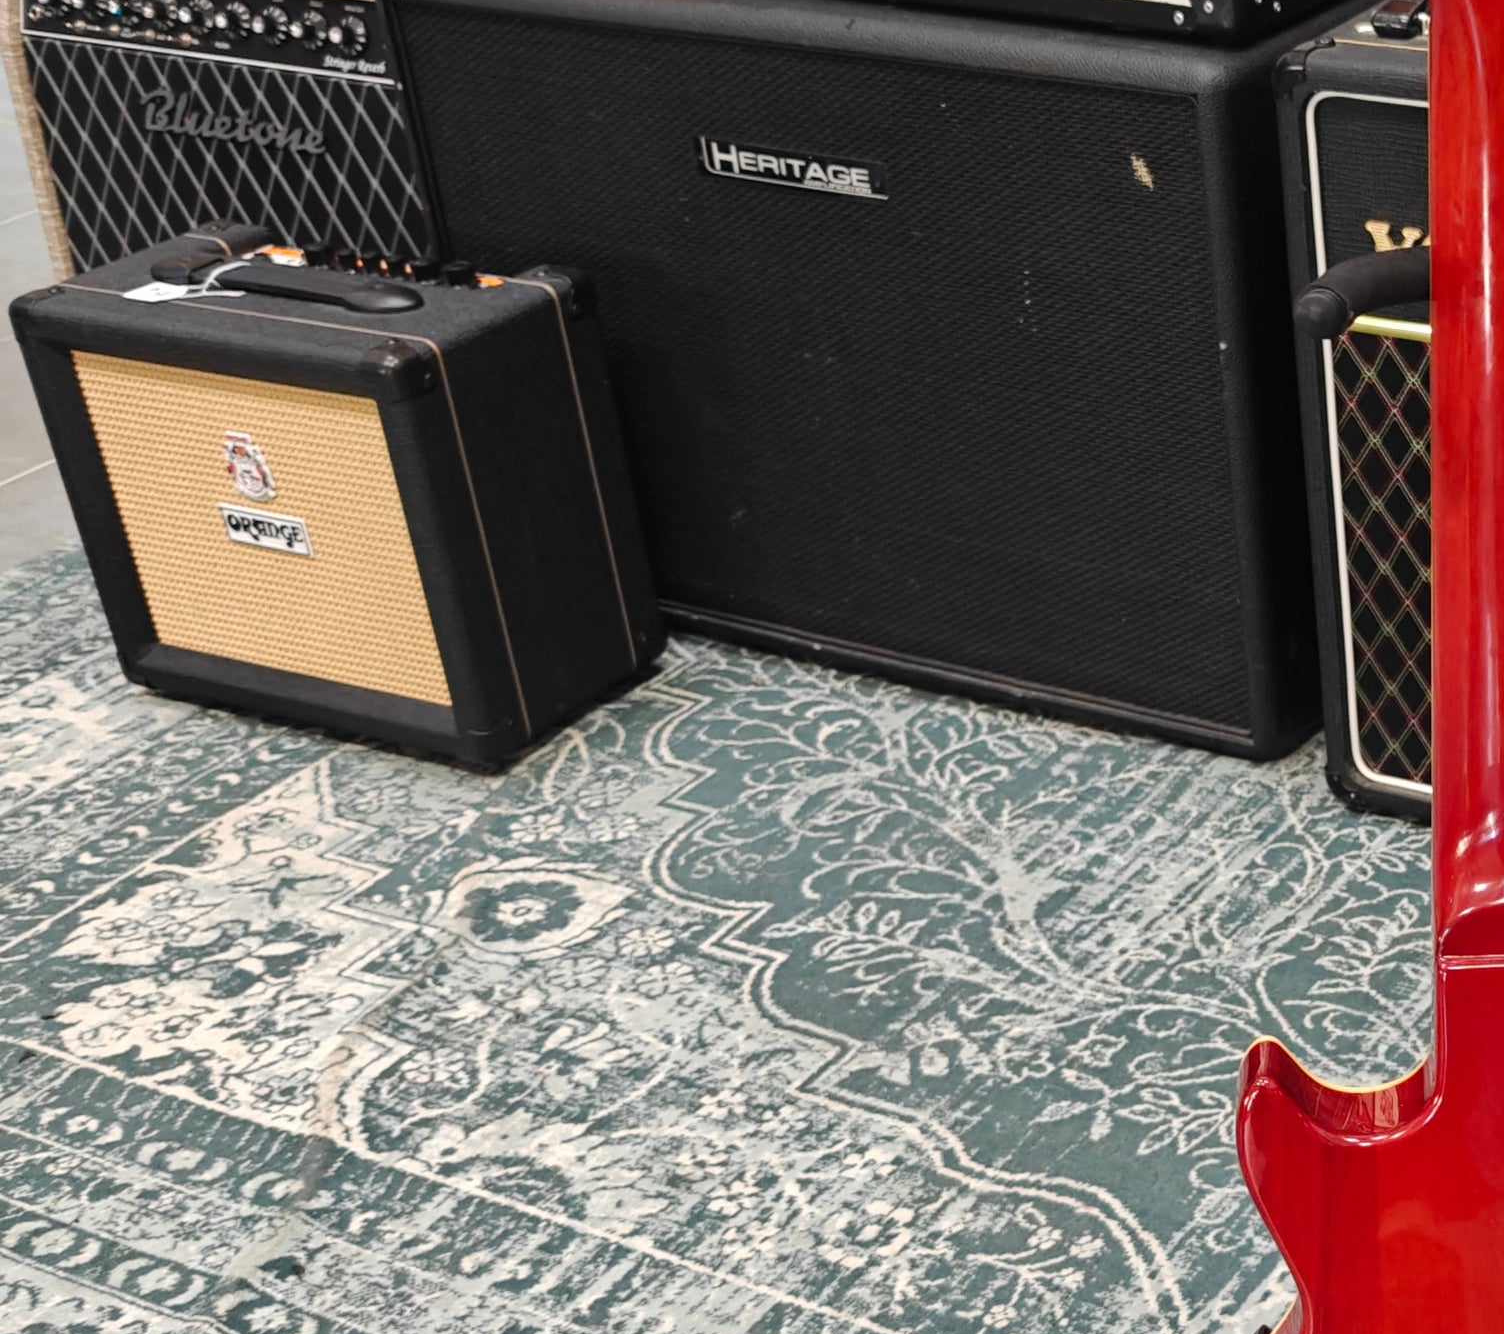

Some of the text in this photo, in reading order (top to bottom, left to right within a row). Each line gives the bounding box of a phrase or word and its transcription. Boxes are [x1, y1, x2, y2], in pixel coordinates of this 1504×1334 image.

[139, 88, 326, 155] Bluetone
[710, 141, 872, 189] HERITAGE
[227, 514, 304, 548] ORANGE
